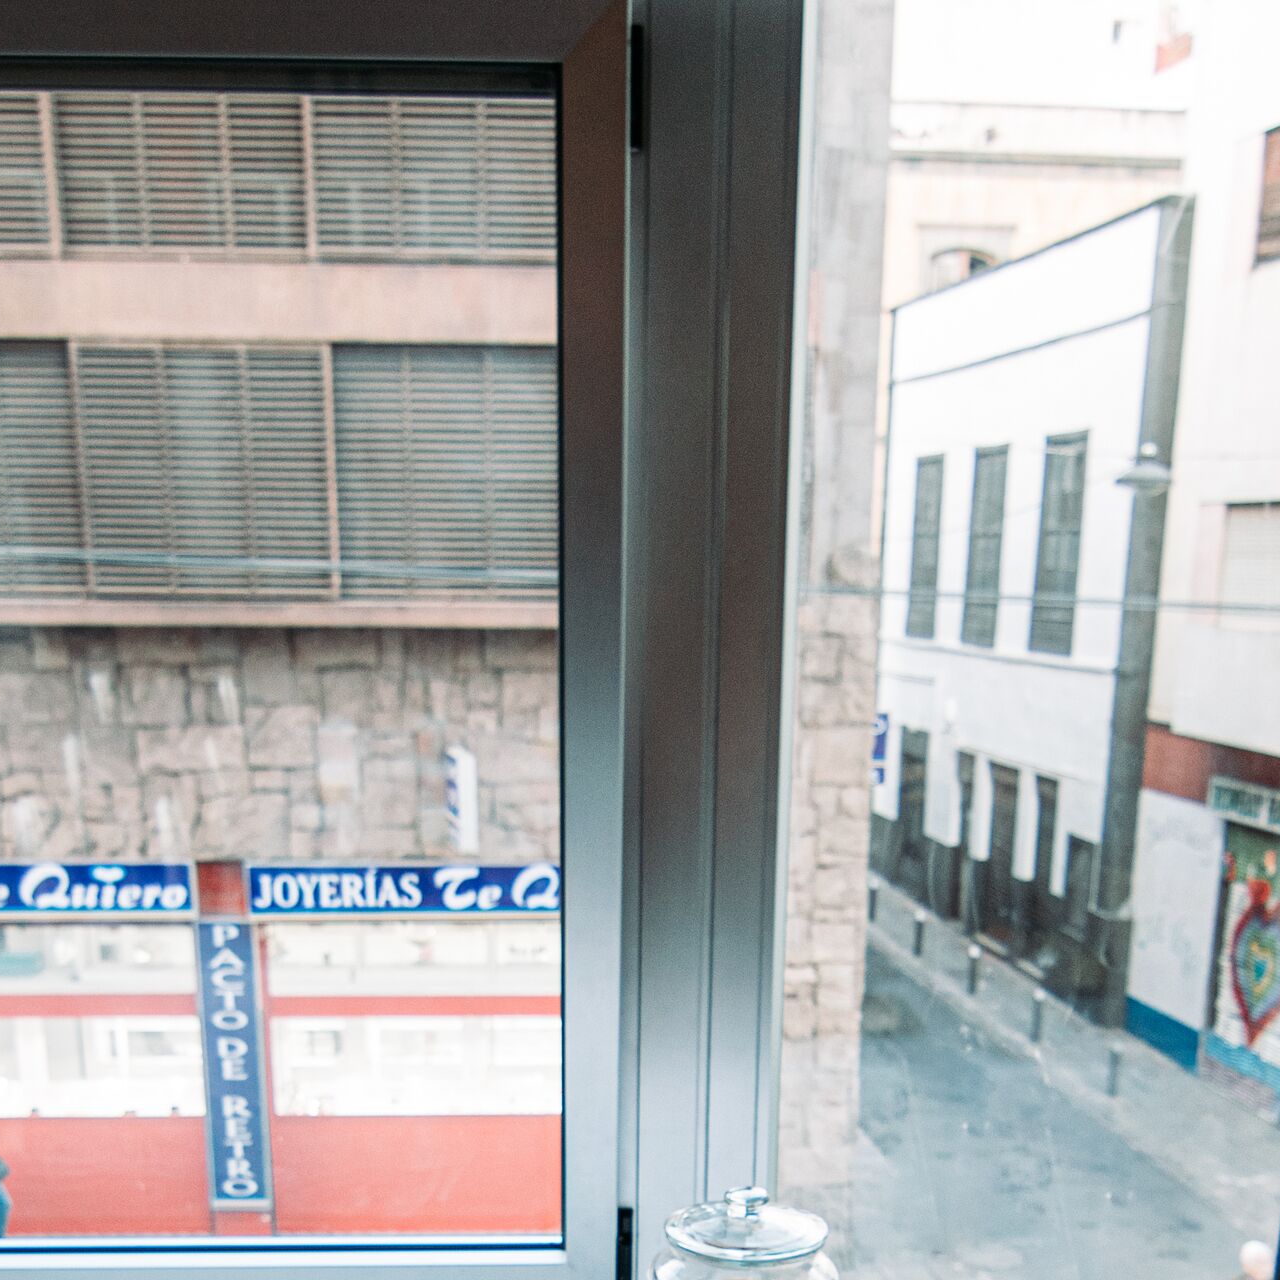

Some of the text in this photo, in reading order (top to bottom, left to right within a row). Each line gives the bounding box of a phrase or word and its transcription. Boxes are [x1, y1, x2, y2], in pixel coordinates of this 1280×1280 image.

[19, 862, 188, 910] Quiero
[253, 867, 423, 910] JOYERÍAS
[432, 866, 502, 910] Te
[209, 924, 259, 1198] PACTO DE RETRO
